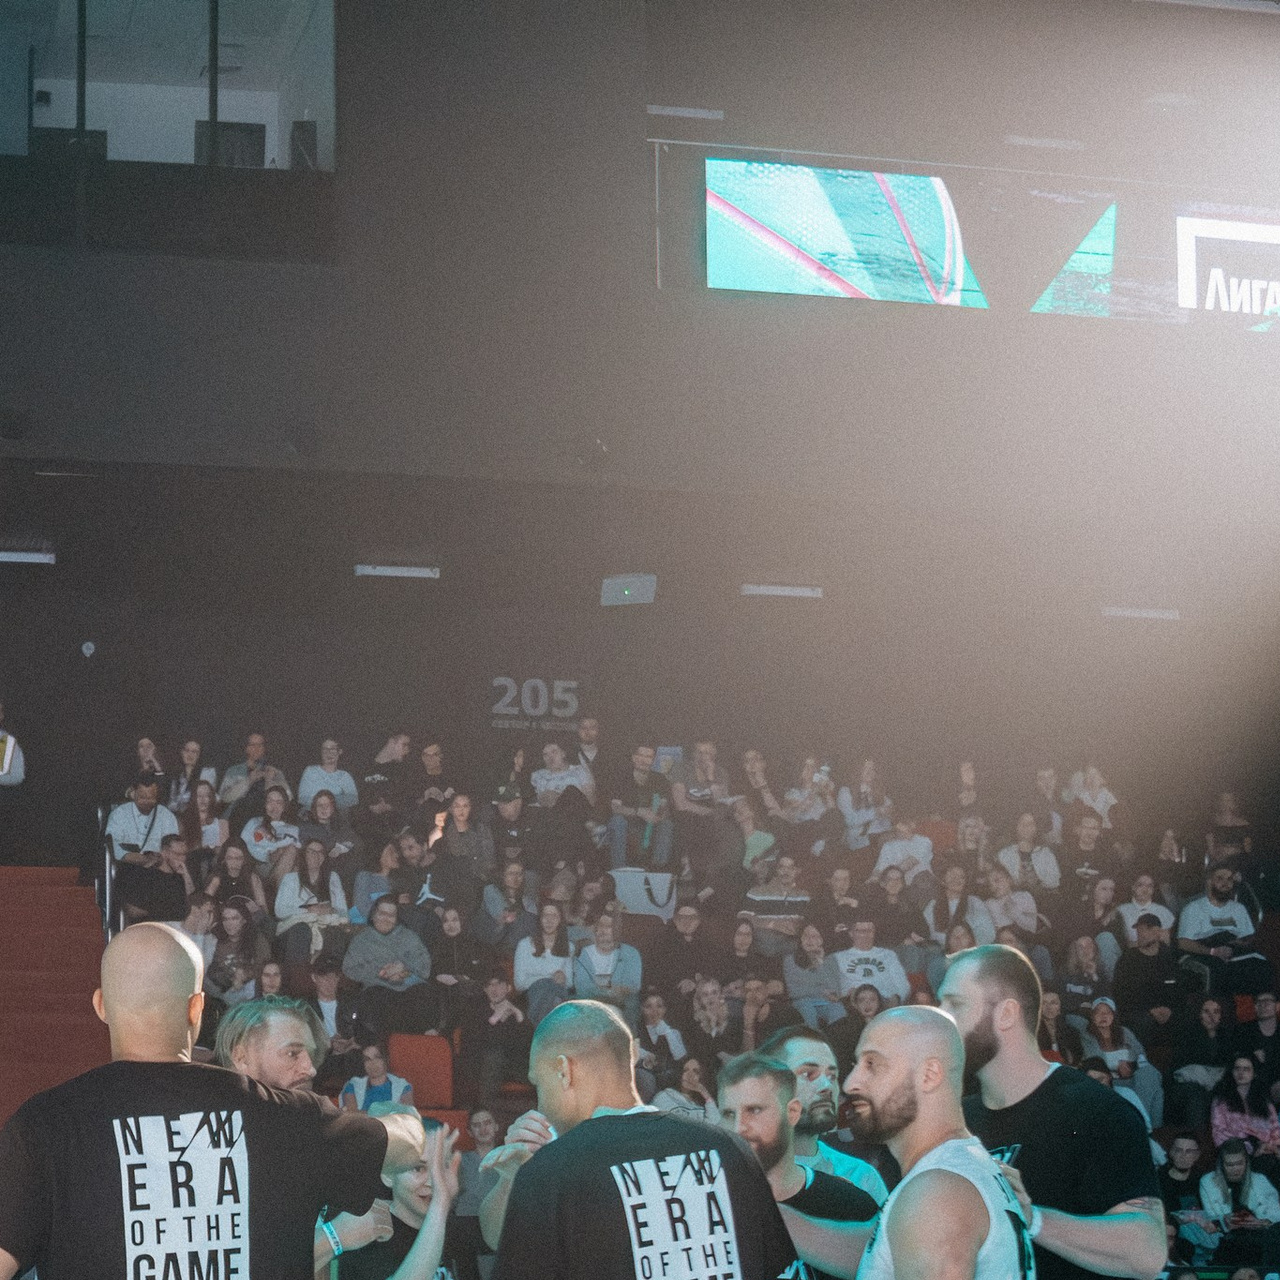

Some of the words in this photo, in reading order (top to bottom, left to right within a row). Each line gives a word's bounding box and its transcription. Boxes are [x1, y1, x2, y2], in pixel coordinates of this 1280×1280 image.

[492, 677, 579, 718] 205
[120, 1112, 241, 1156] NEW
[126, 1156, 241, 1212] ERA
[619, 1150, 718, 1198] NEW
[131, 1218, 167, 1246] OF
[183, 1213, 241, 1242] THE
[630, 1191, 728, 1249] ERA
[640, 1252, 670, 1280] OF
[681, 1241, 733, 1272] THE
